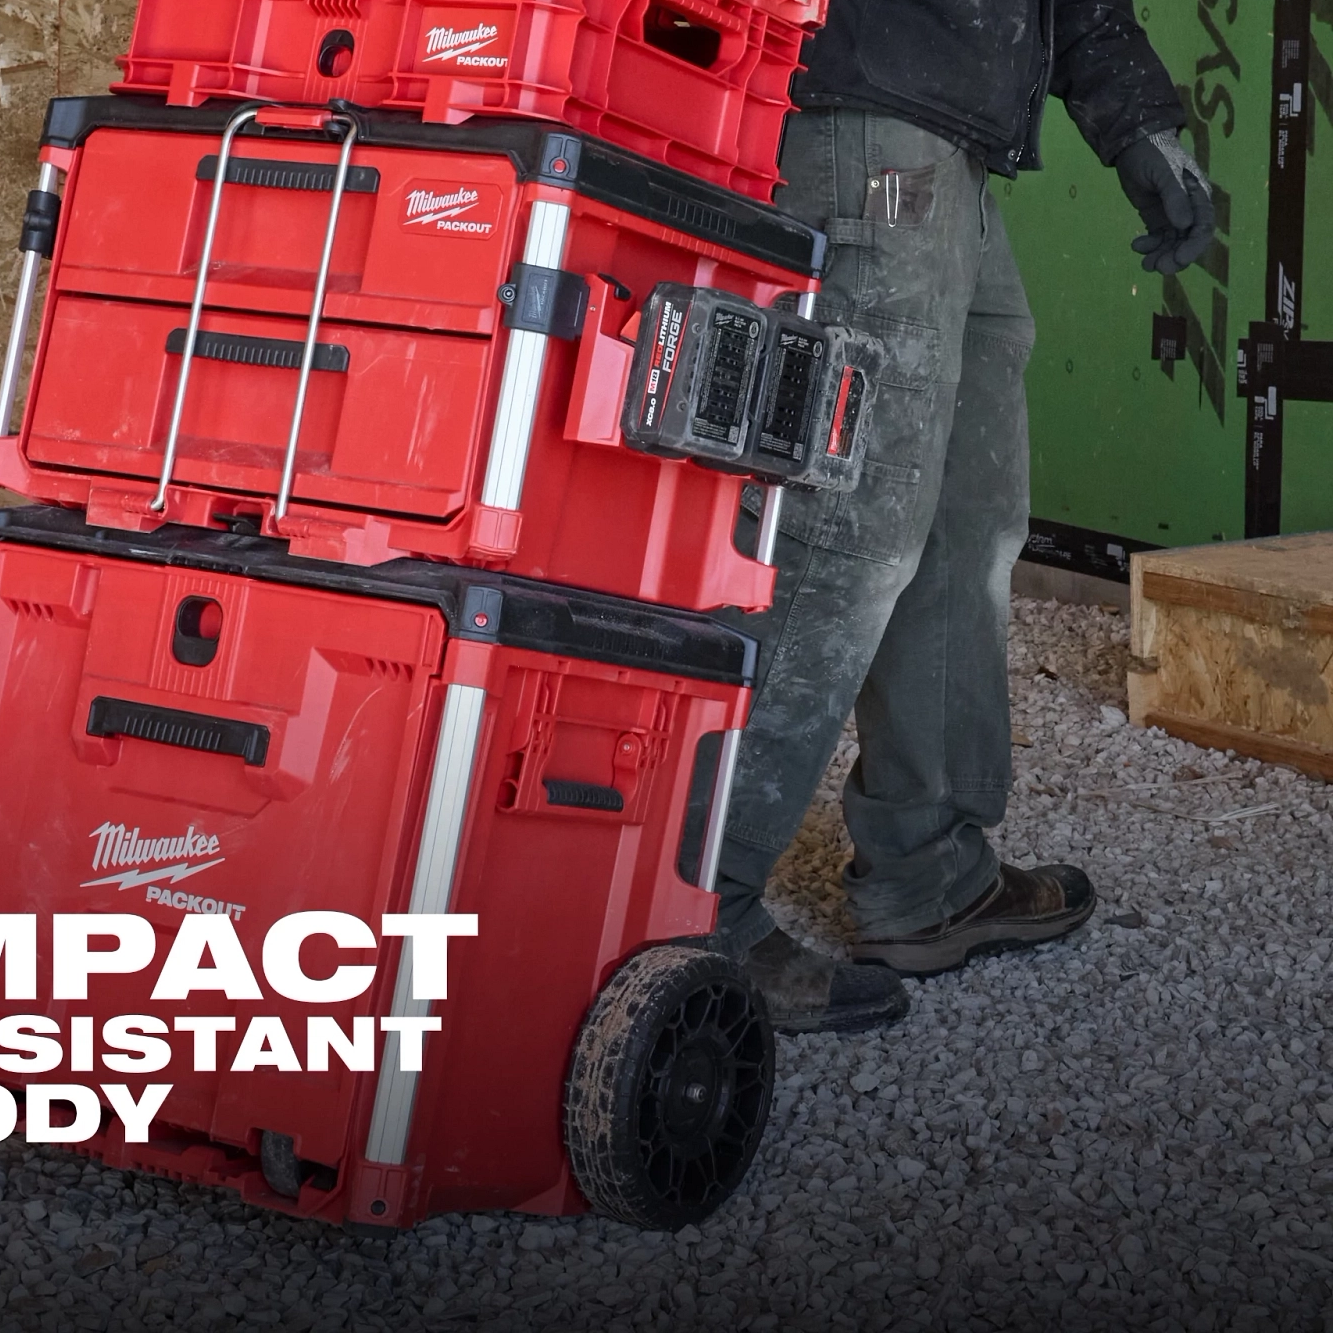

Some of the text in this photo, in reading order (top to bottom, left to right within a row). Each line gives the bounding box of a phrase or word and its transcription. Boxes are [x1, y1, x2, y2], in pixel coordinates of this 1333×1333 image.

[425, 23, 498, 54] Milwaukee
[456, 56, 509, 68] PACKOUT
[405, 187, 479, 217] Milwaukee
[437, 220, 493, 234] PACKOUT
[662, 309, 683, 373] FORGE
[89, 821, 221, 872] Milwaukee
[145, 886, 246, 921] PACKOUT
